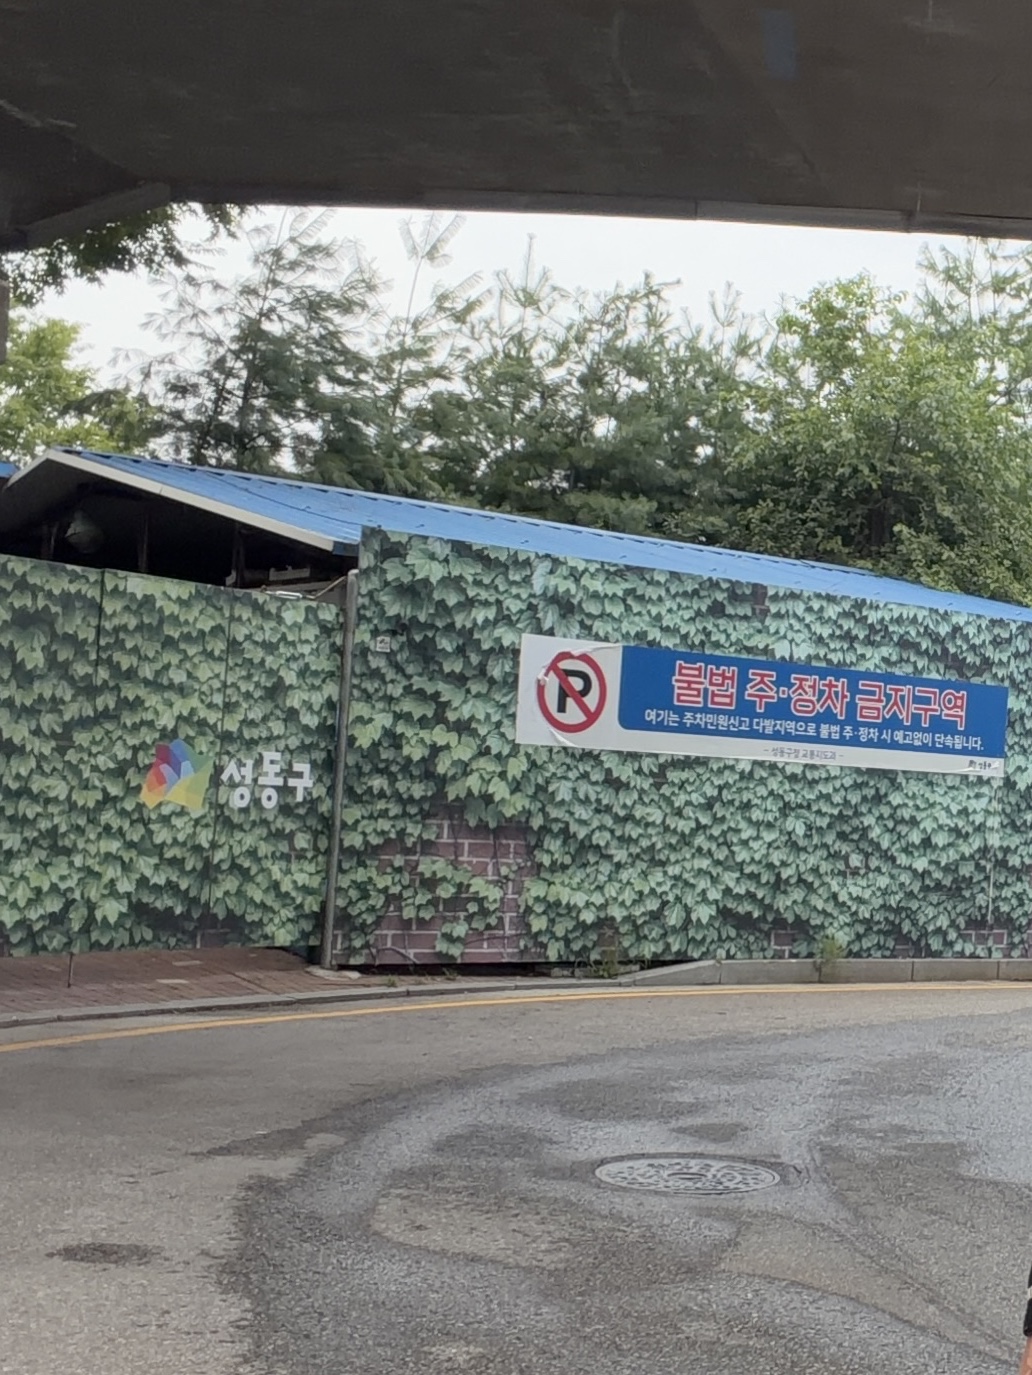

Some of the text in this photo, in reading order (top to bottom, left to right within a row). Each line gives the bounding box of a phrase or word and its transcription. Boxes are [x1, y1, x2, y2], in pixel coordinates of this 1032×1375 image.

[672, 660, 967, 731] 불법 주·정차 금지구역
[644, 708, 984, 751] 여기는 주차민원신고 다발지역으로 불법 주·정차 시 예고없이 단속됩니다.
[220, 751, 314, 809] 성동구
